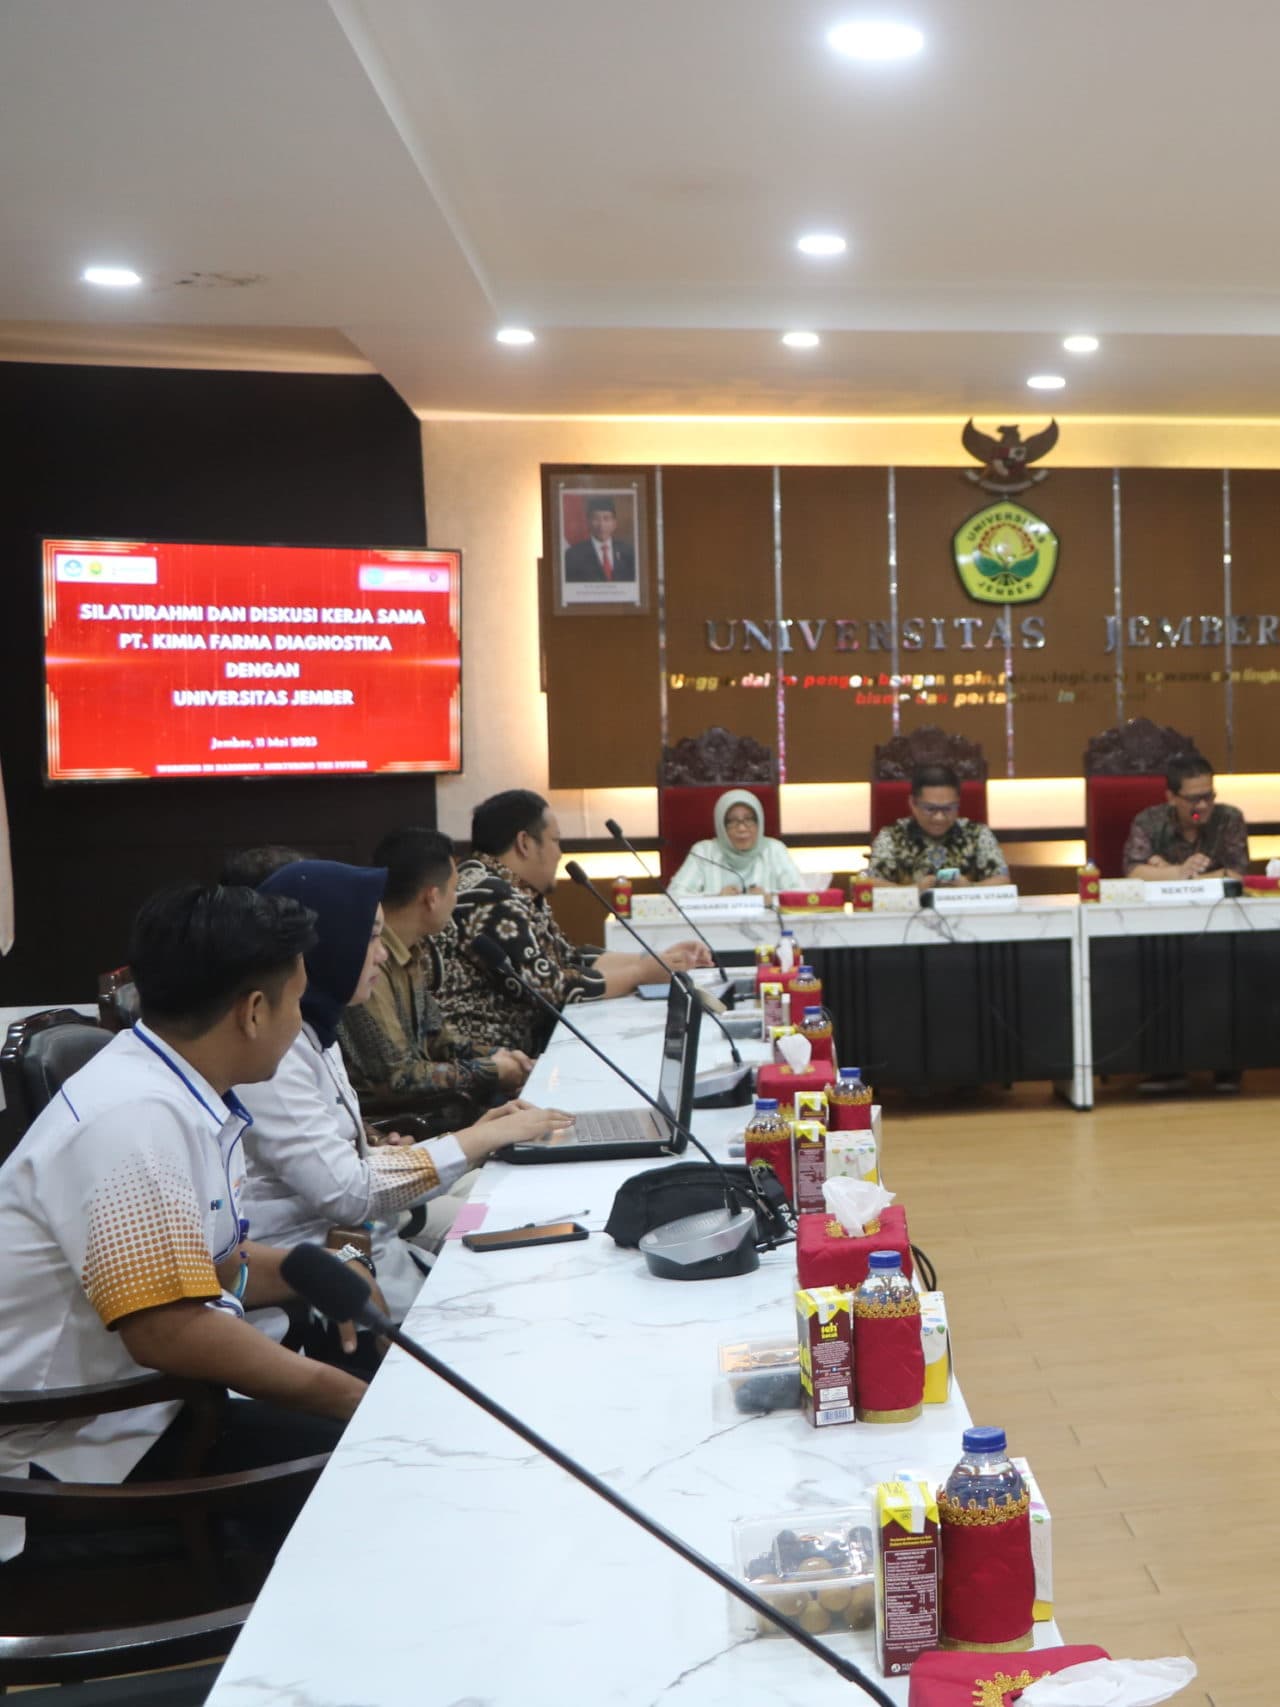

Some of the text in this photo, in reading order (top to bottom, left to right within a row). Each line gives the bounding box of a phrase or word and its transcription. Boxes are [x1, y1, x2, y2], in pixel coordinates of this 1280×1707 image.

[80, 604, 425, 624] SILATURAHMI DAN DISKUSI KERJA SAMA
[705, 613, 1280, 651] UNIVERSITAS JEMBER
[120, 633, 392, 651] PT. KIMIA FARMA DIAGNOSTIKA
[226, 662, 299, 678] DENGAN
[174, 690, 354, 706] UNIVERSITAS JEMBER
